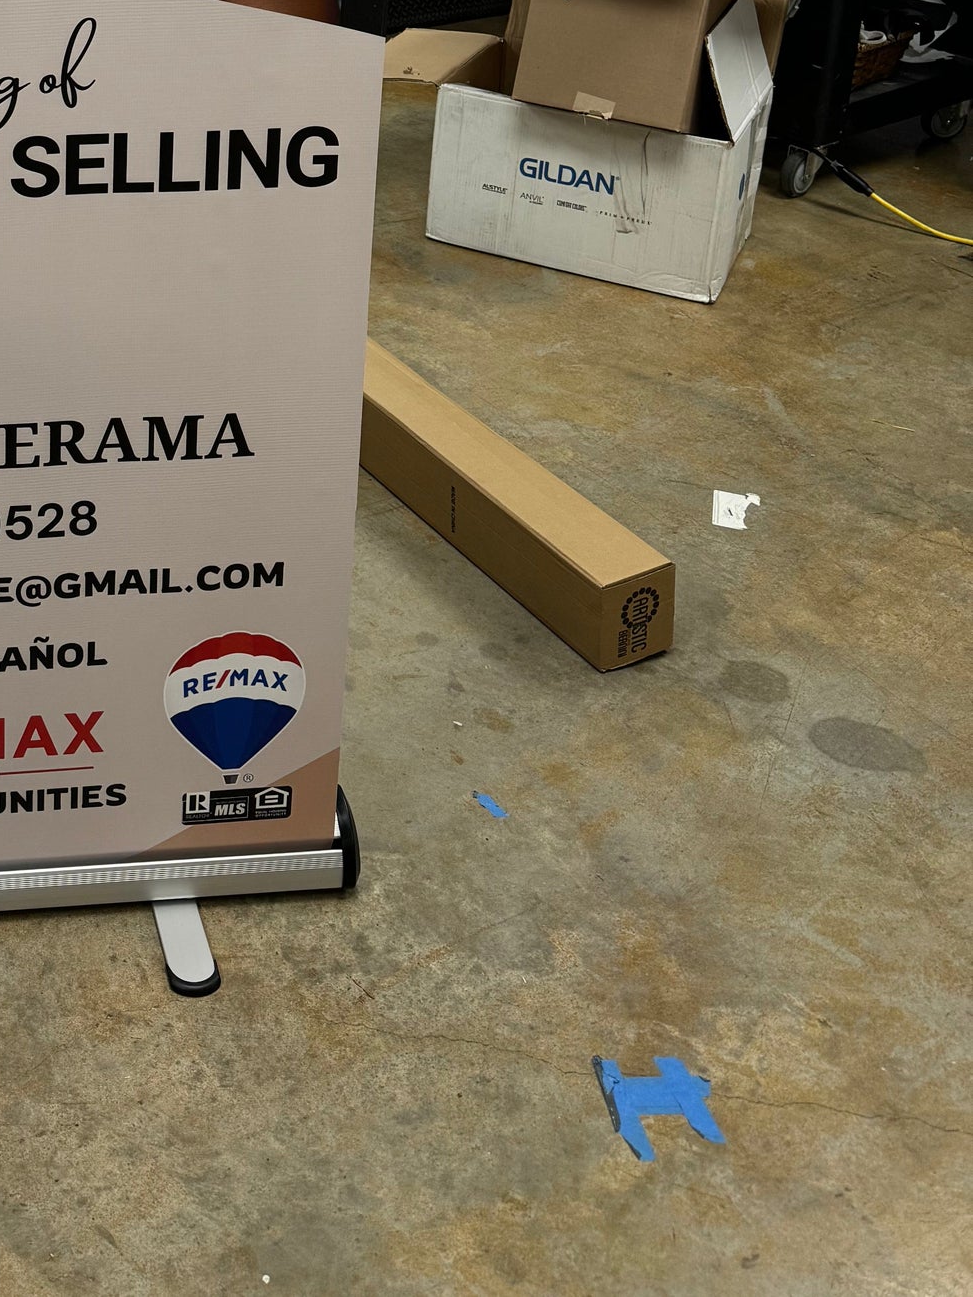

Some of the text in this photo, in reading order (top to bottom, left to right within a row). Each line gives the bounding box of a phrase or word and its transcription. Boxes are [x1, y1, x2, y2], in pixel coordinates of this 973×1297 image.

[38, 17, 97, 109] of
[10, 125, 340, 199] SELLING
[518, 156, 616, 196] GILDAN
[520, 192, 544, 203] ANVIL
[631, 597, 649, 653] ARTISTIC
[183, 668, 289, 699] RE/MAX
[214, 802, 246, 817] MLS
